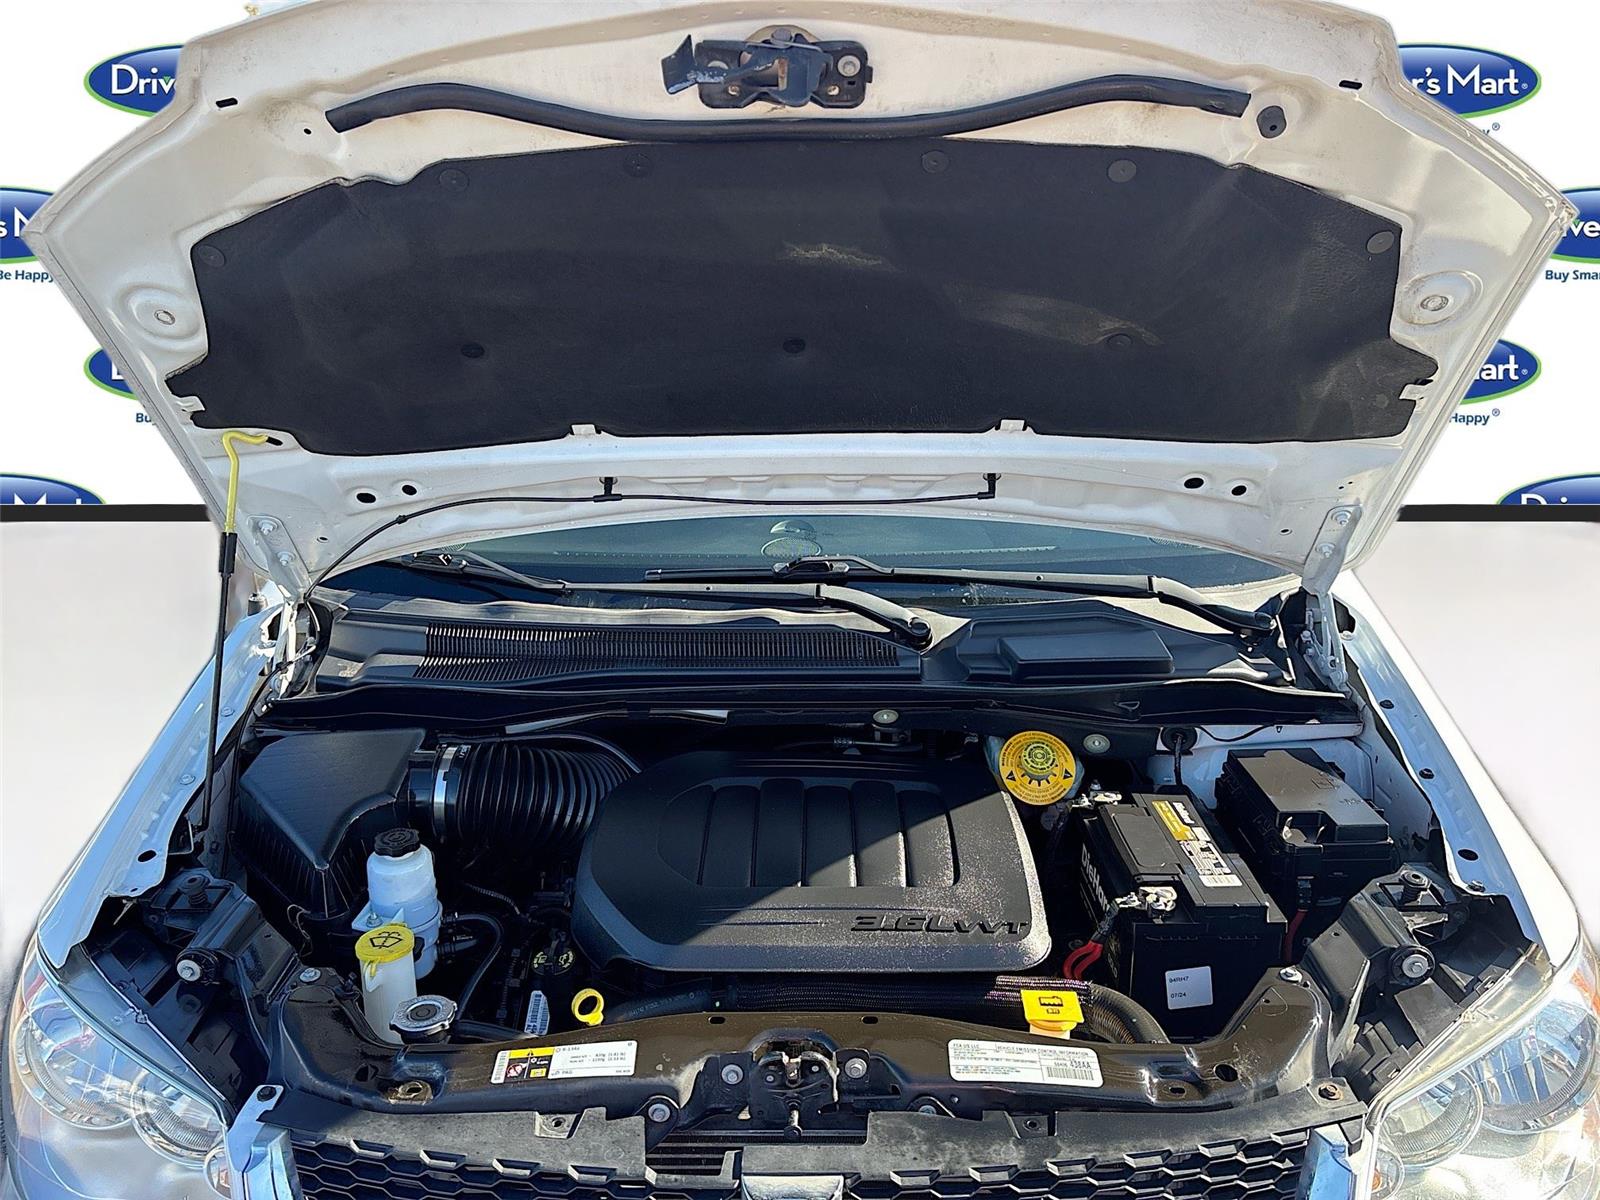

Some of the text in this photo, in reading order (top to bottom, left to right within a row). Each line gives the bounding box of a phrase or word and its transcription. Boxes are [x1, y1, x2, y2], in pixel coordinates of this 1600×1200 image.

[111, 64, 176, 95] Driv
[1447, 64, 1519, 95] Mart
[1545, 270, 1569, 283] Buy
[1474, 355, 1519, 380] art
[136, 413, 157, 425] Bu
